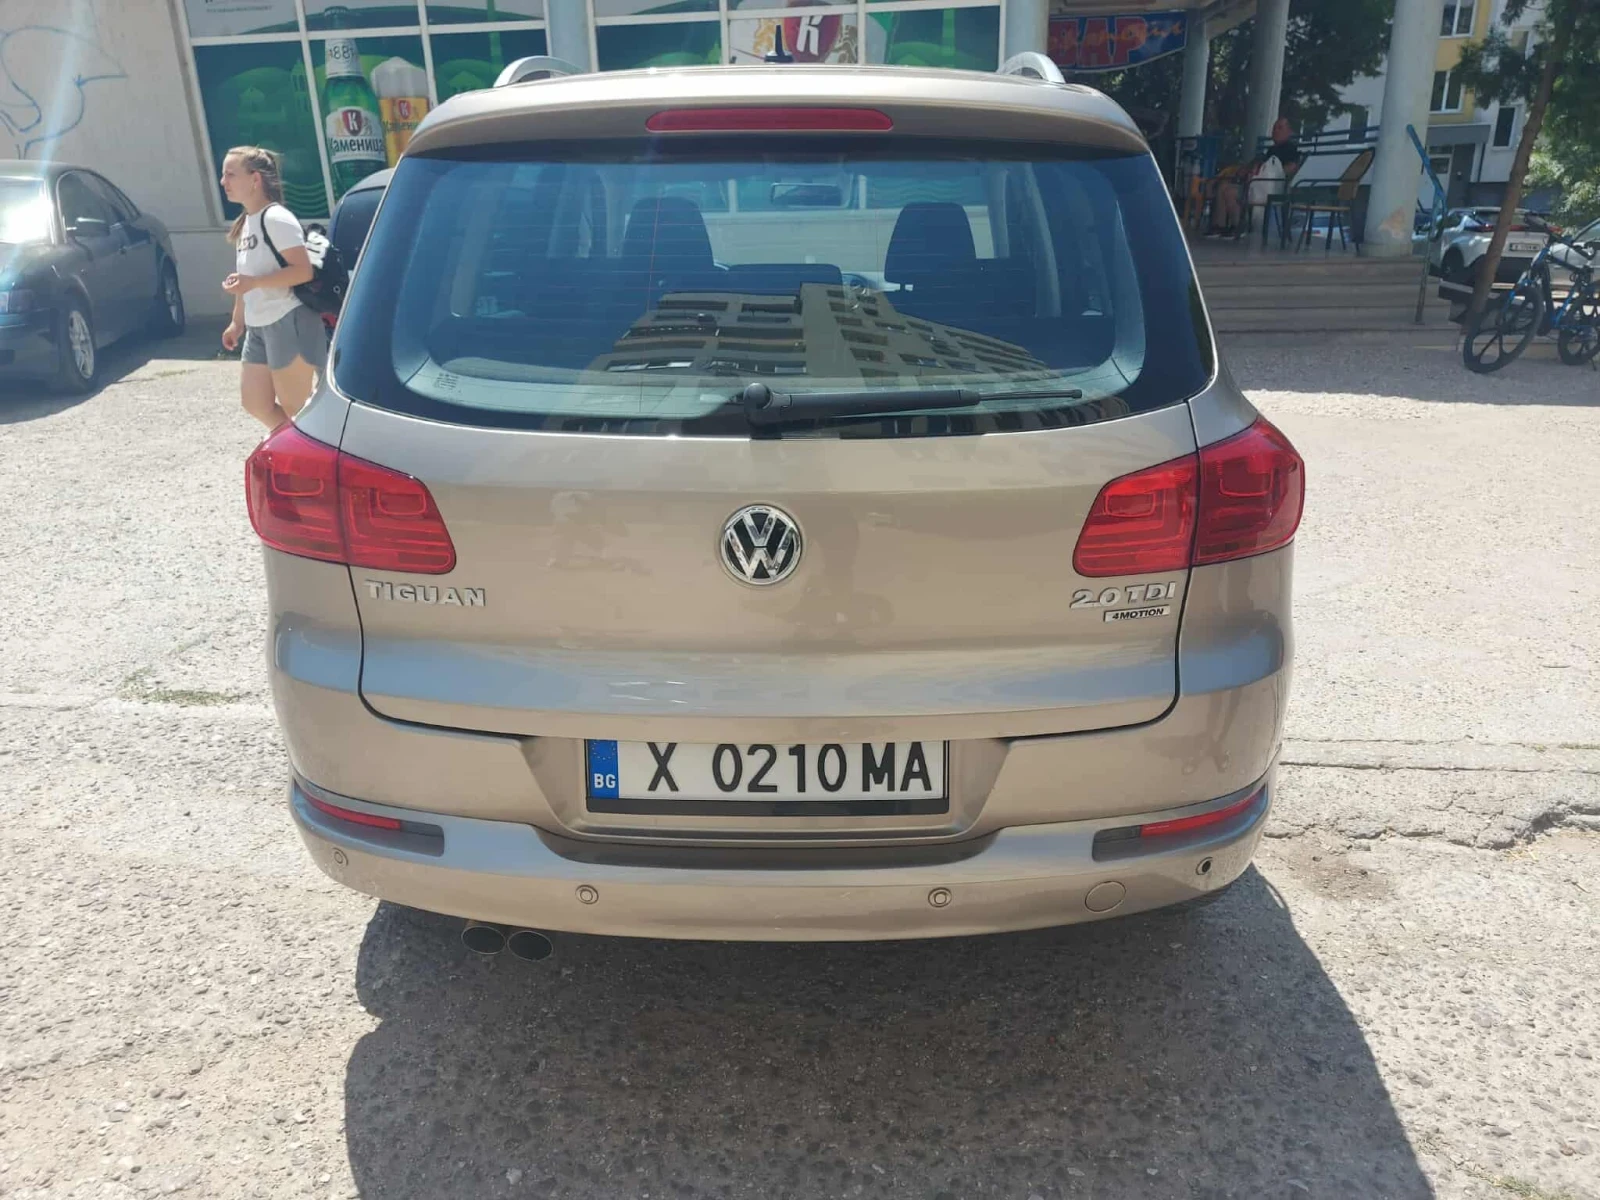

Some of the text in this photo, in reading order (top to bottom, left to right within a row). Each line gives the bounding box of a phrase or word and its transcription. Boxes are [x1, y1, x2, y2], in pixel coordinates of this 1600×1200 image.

[362, 579, 486, 607] TIGUAN
[1124, 581, 1176, 604] TDI
[1112, 607, 1165, 620] 4MOTION
[646, 741, 933, 793] X 0210 MA
[593, 773, 616, 789] BG
